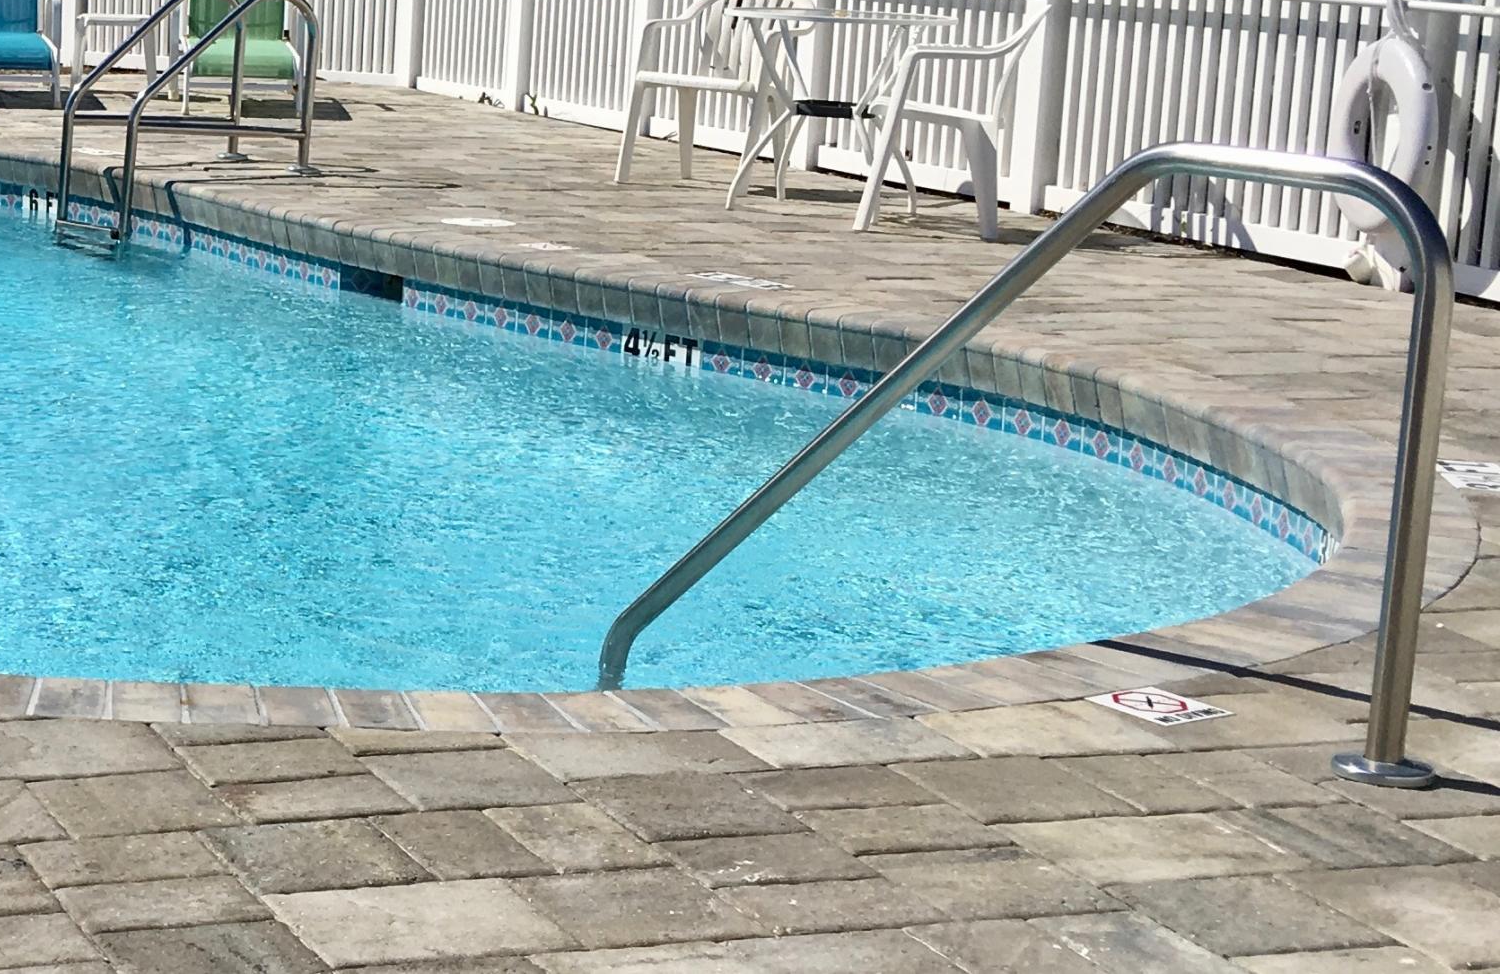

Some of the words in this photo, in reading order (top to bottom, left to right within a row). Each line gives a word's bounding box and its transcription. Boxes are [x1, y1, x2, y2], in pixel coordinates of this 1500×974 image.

[46, 191, 59, 214] F
[664, 334, 699, 367] FT
[1154, 715, 1181, 724] NO
[1175, 707, 1227, 720] DIVING
